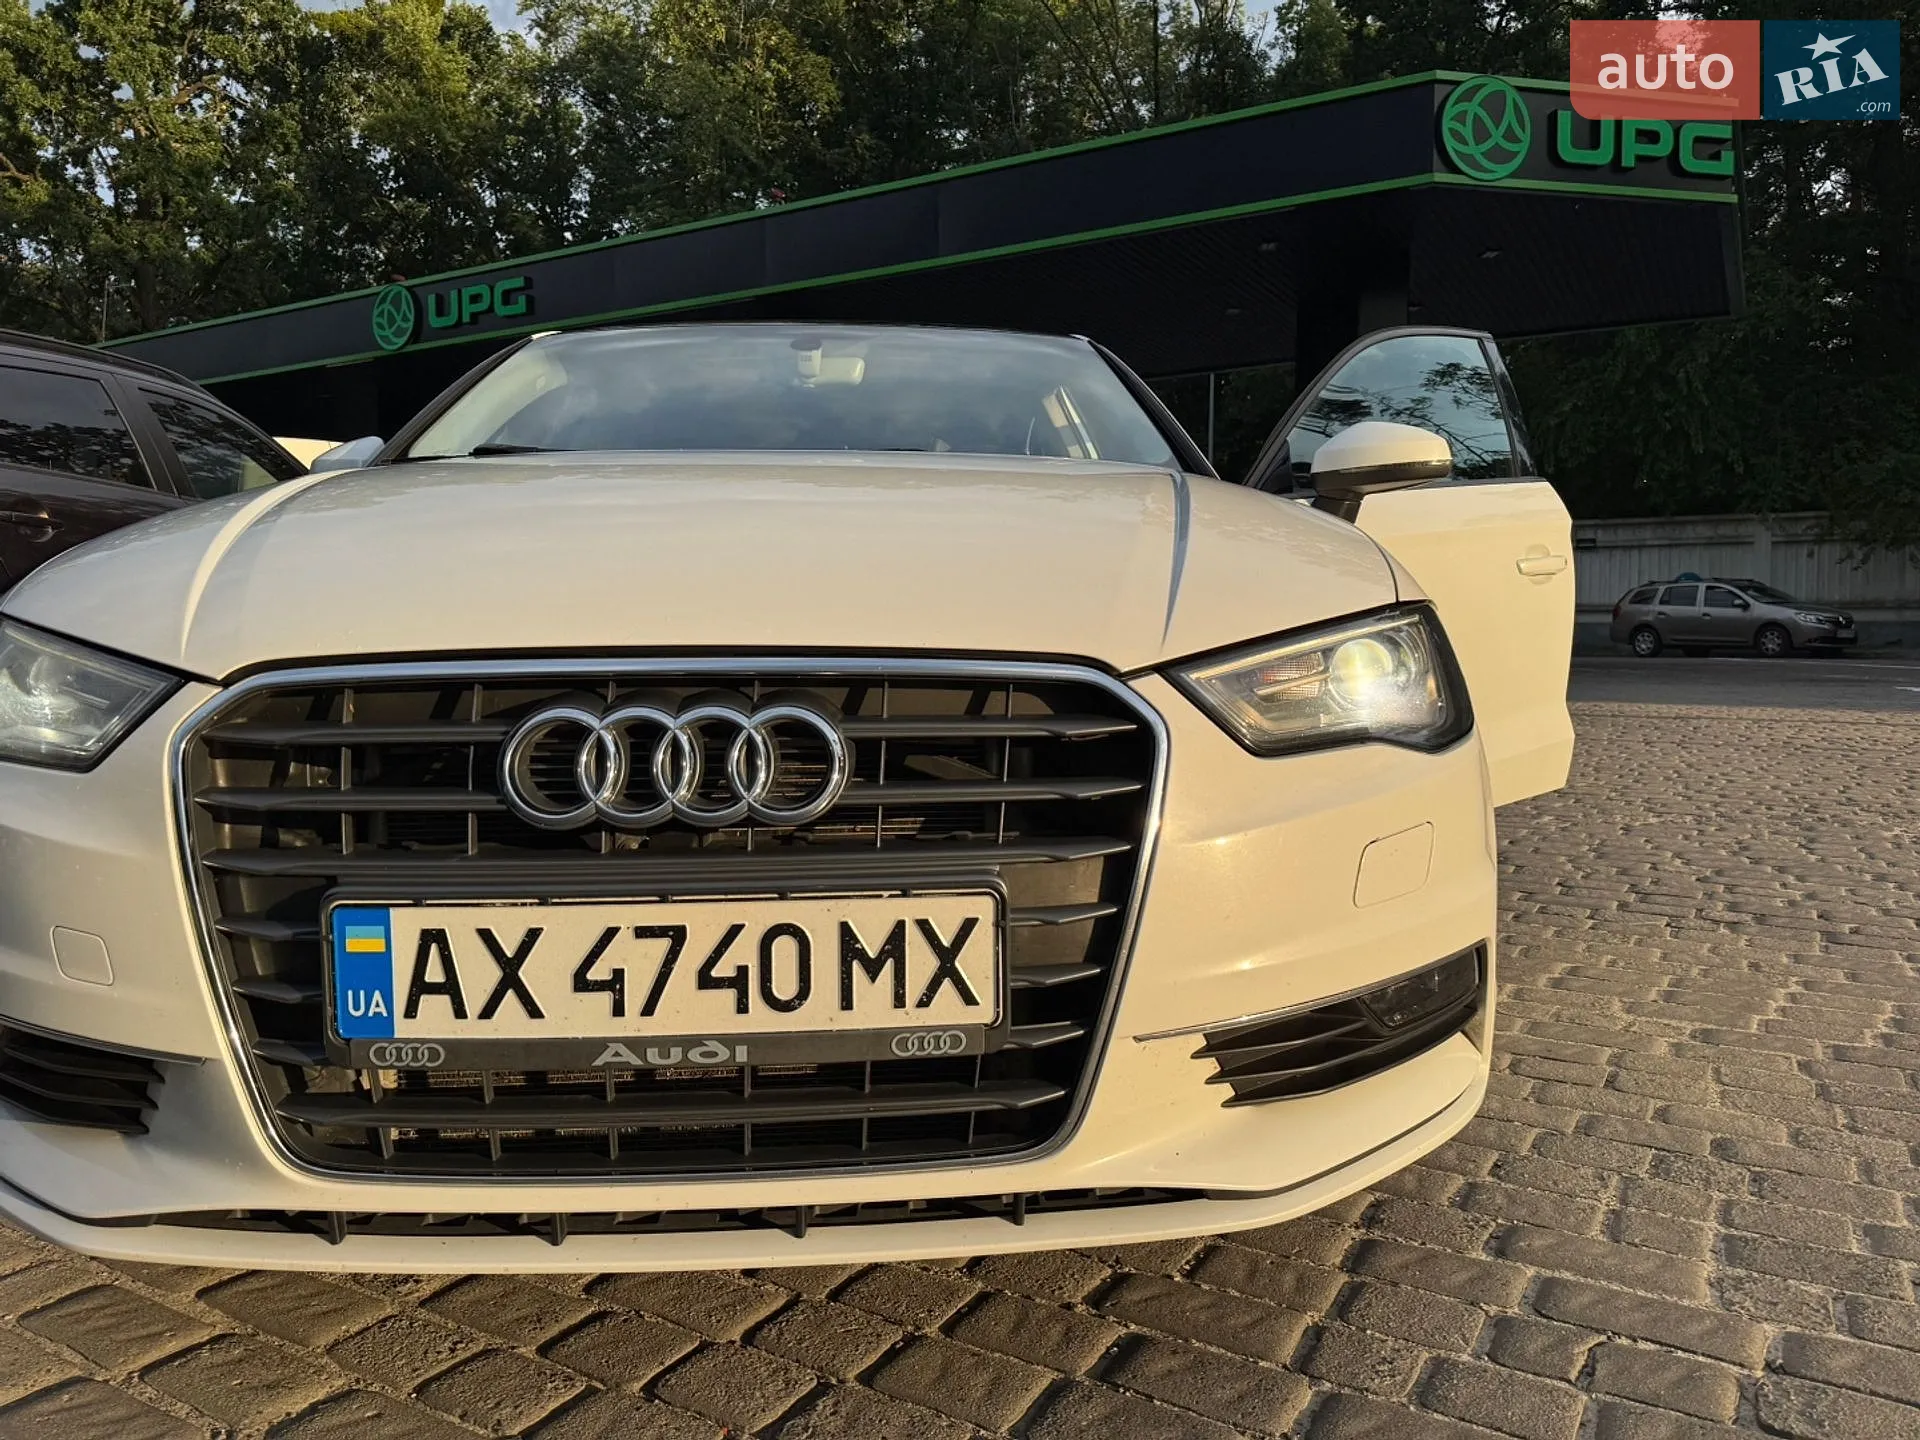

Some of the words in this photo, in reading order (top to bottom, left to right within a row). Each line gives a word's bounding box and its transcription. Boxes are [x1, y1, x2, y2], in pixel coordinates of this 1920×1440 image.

[1556, 109, 1735, 176] UPG
[427, 275, 527, 328] UPG
[403, 926, 545, 1019] AX
[573, 922, 812, 1018] 4740
[839, 916, 981, 1011] MX
[347, 988, 388, 1018] UA
[591, 1039, 748, 1066] Audi
